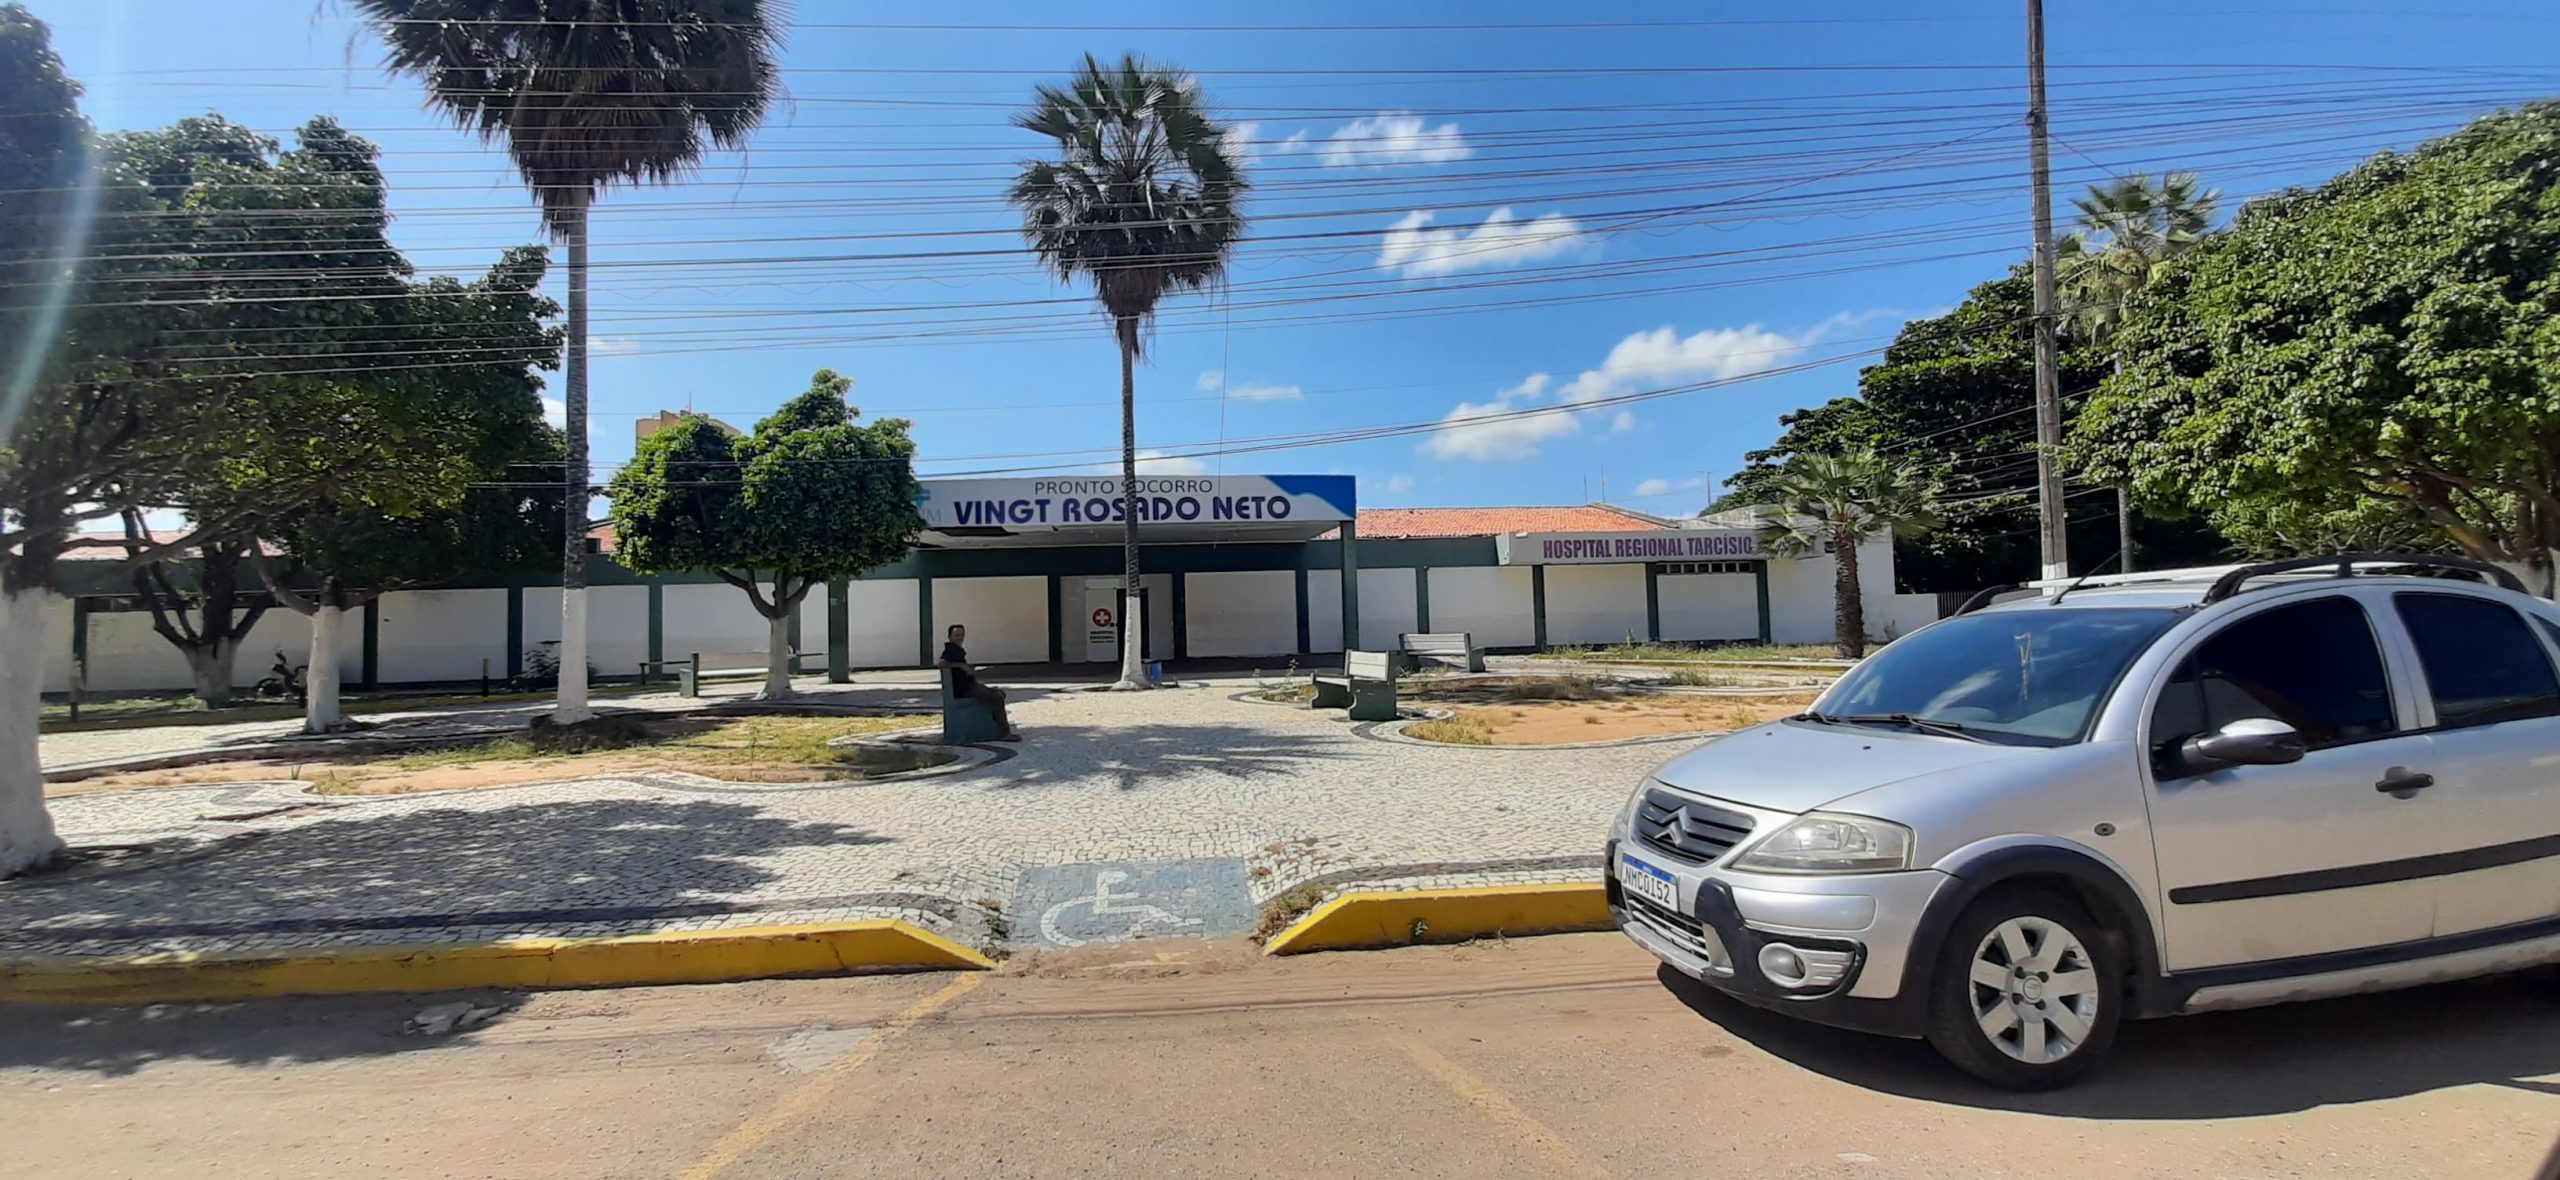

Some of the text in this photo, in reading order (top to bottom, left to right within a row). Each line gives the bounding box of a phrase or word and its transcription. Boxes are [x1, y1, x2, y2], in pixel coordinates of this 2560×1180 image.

[1034, 481, 1115, 495] PRONTO
[954, 496, 1291, 525] VINGT ROSADO NETO
[1542, 533, 1753, 559] HOSPITAL REGIONAL TARCÍSIO
